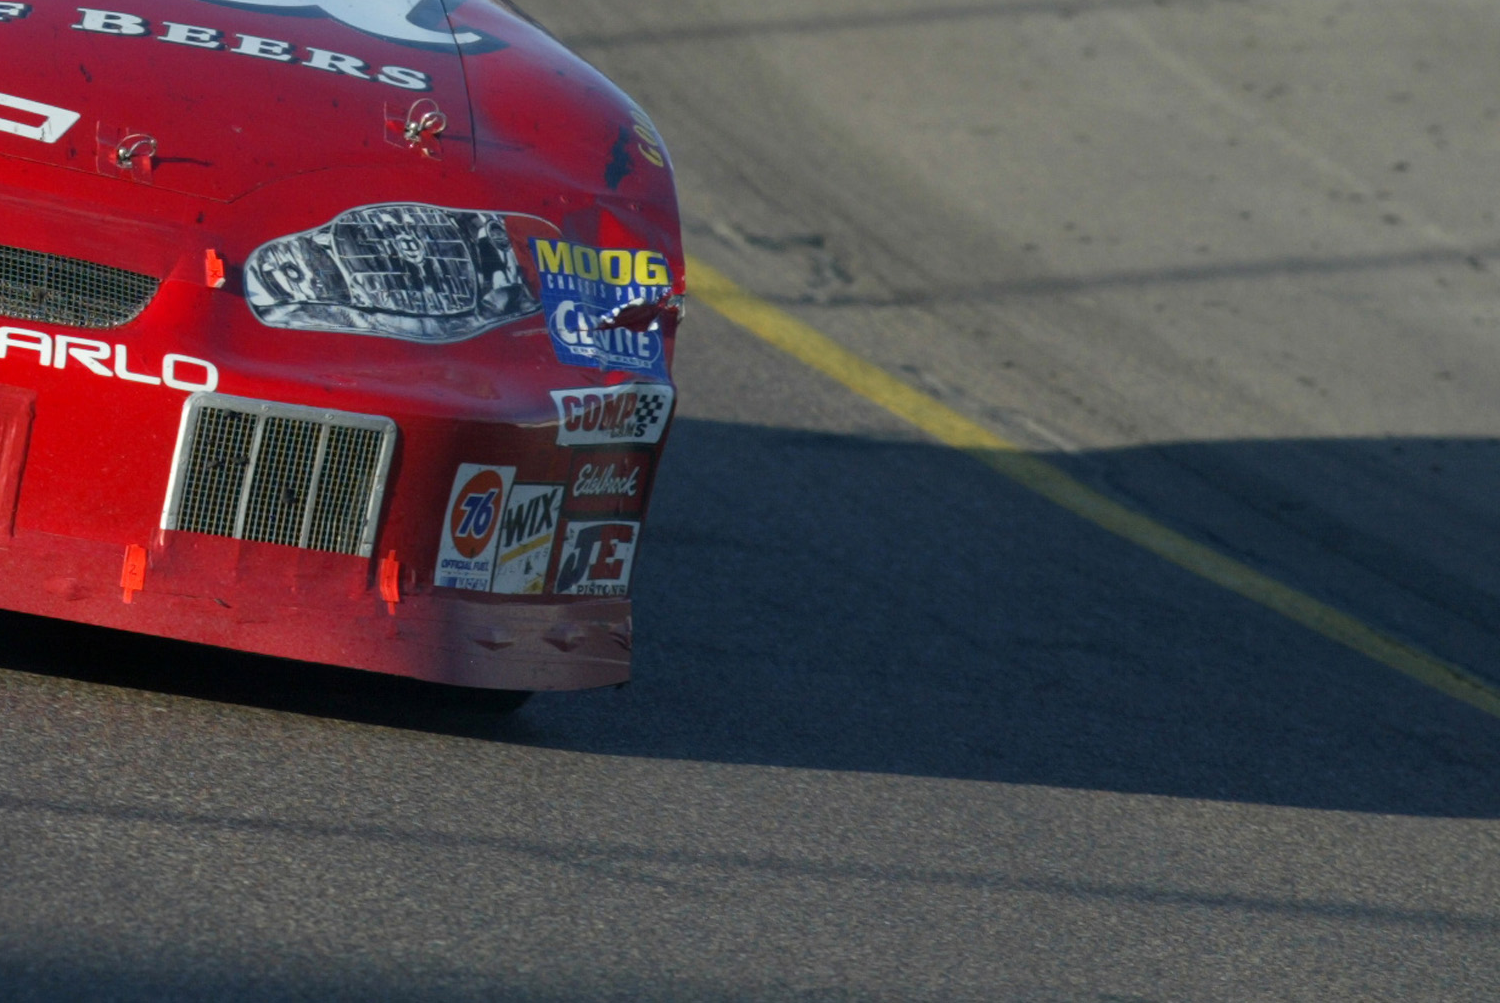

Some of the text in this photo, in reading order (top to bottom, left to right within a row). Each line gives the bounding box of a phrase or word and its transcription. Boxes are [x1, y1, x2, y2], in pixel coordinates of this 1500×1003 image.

[71, 7, 431, 92] BEERS
[534, 239, 669, 286] MOOG
[562, 393, 638, 432] COMP
[610, 422, 648, 439] CAMS
[573, 462, 640, 497] Edelbrock
[457, 490, 497, 538] 76
[502, 489, 558, 548] WIX
[556, 523, 634, 592] JE
